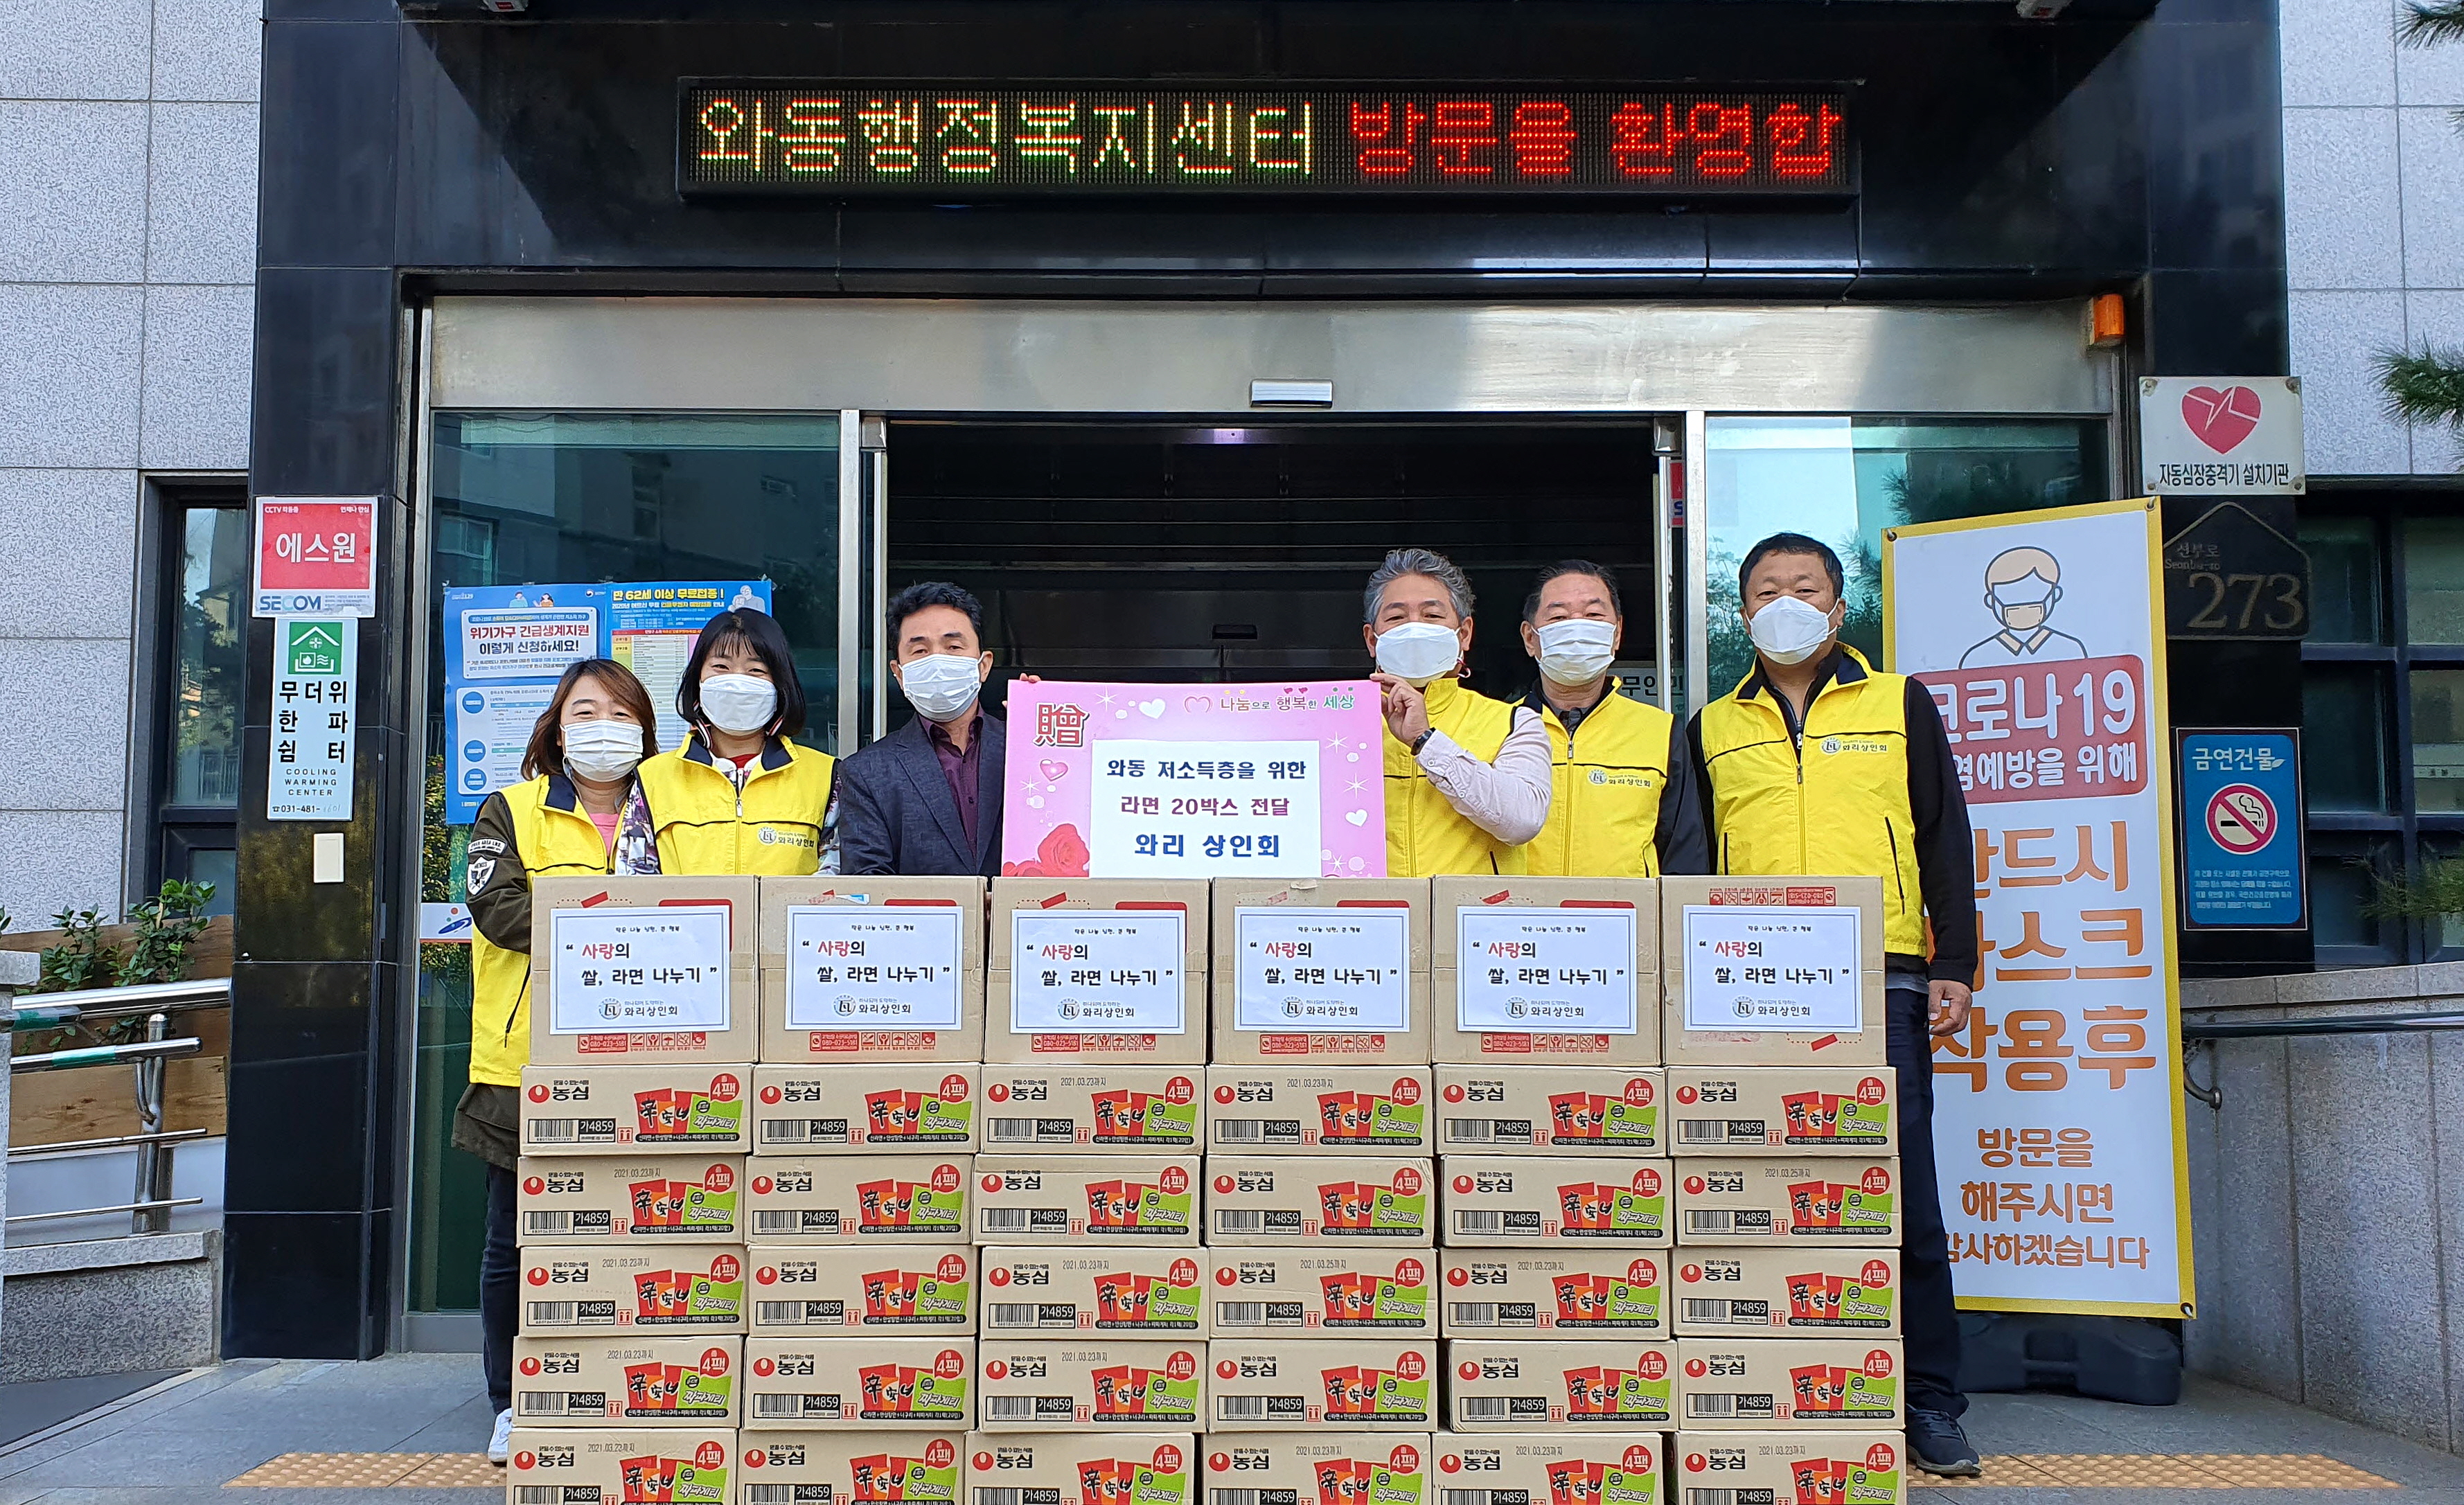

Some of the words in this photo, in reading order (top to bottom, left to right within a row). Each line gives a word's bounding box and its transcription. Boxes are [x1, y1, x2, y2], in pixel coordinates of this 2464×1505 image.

[695, 98, 1314, 176] 와동행정복지센터
[1350, 101, 1576, 176] 방문을
[1610, 100, 1836, 176] 환영합
[2159, 463, 2239, 486] 자동심장충격기
[2243, 463, 2289, 486] 설치기관
[276, 533, 355, 563] 에스원
[626, 589, 652, 601] 62세
[654, 589, 675, 600] 이상
[2186, 572, 2304, 630] 273
[260, 596, 321, 611] SECOM
[470, 626, 516, 640] 위기가구
[520, 625, 590, 638] 긴급생계지원
[479, 642, 513, 654] 이렇게
[517, 640, 579, 653] 신청하세요!
[280, 680, 348, 705] 무더위
[1221, 696, 1271, 712] 나눔으로
[1276, 694, 1318, 711] 행복한
[1322, 694, 1355, 710] 세상
[2073, 670, 2136, 737] 19
[1034, 704, 1086, 747] 贈
[2077, 741, 2137, 784] 위해
[2192, 747, 2276, 771] 금연건물
[1107, 760, 1146, 778] 와동
[1158, 760, 1256, 779] 저소득층을
[1267, 761, 1306, 779] 위한
[1121, 796, 1159, 815] 라면
[1171, 798, 1239, 816] 20박스
[1250, 798, 1290, 816] 전달
[1135, 835, 1185, 857] 와리
[1202, 835, 1280, 858] 상인회
[582, 943, 630, 959] 사랑의
[817, 941, 865, 956] 사랑의
[1042, 945, 1088, 960] 사랑의
[1266, 942, 1312, 958] 사랑의
[1488, 942, 1536, 958] 사랑의
[1714, 941, 1762, 957] 사랑의
[582, 970, 603, 986] 쌀,
[612, 968, 644, 985] 라면
[653, 967, 700, 983] 나누기
[817, 967, 837, 983] 쌀,
[847, 967, 878, 983] 라면
[887, 966, 934, 982] 나누기
[1041, 970, 1062, 986] 쌀,
[1071, 970, 1101, 986] 라면
[1110, 970, 1157, 986] 나누기
[1265, 968, 1285, 984] 쌀,
[1295, 968, 1325, 984] 라면
[1334, 969, 1381, 985] 나누기
[1488, 968, 1509, 984] 쌀,
[1518, 968, 1550, 984] 라면
[1559, 969, 1606, 985] 나누기
[1714, 968, 1735, 983] 쌀,
[1745, 968, 1775, 984] 라면
[1786, 968, 1832, 984] 나누기
[624, 1006, 677, 1017] 와리상인회
[859, 1004, 911, 1013] 와리상인회
[1083, 1008, 1135, 1017] 와리상인회
[1306, 1006, 1358, 1016] 와리상인회
[1531, 1007, 1584, 1017] 와리상인회
[1757, 1006, 1810, 1016] 와리상인회
[552, 1085, 590, 1101] 농심
[711, 1084, 736, 1098] 4팩
[784, 1087, 820, 1102] 농심
[941, 1085, 966, 1099] 4팩
[1011, 1085, 1047, 1101] 농심
[1167, 1087, 1191, 1101] 4팩
[1237, 1087, 1273, 1102] 농심
[1393, 1088, 1418, 1103] 4팩
[1467, 1086, 1505, 1102] 농심
[1700, 1087, 1737, 1103] 농심
[580, 1120, 614, 1132] 가4859
[812, 1121, 845, 1132] 가4859
[1038, 1121, 1072, 1132] 가4859
[1265, 1121, 1298, 1132] 가4859
[1496, 1121, 1530, 1133] 가4859
[1729, 1121, 1764, 1133] 가4859
[1978, 1126, 2094, 1168] 방문을
[547, 1177, 584, 1193] 농심
[775, 1177, 813, 1193] 농심
[1004, 1175, 1042, 1191] 농심
[1238, 1177, 1274, 1192] 농심
[1476, 1177, 1514, 1193] 농심
[1707, 1177, 1744, 1193] 농심
[1960, 1179, 2114, 1224] 해주시면
[551, 1267, 589, 1283] 농심
[779, 1267, 818, 1283] 농심
[1012, 1270, 1049, 1285] 농심
[1239, 1268, 1275, 1283] 농심
[1471, 1269, 1508, 1285] 농심
[1703, 1265, 1742, 1282] 농심
[542, 1358, 580, 1374] 농심
[777, 1360, 815, 1376] 농심
[1009, 1362, 1047, 1378] 농심
[1240, 1362, 1277, 1378] 농심
[1482, 1363, 1519, 1379] 농심
[1708, 1360, 1746, 1376] 농심
[538, 1452, 575, 1468] 농심
[768, 1450, 806, 1466] 농심
[996, 1453, 1034, 1469] 농심
[1232, 1454, 1270, 1470] 농심
[1464, 1455, 1501, 1471] 농심
[1709, 1454, 1746, 1470] 농심
